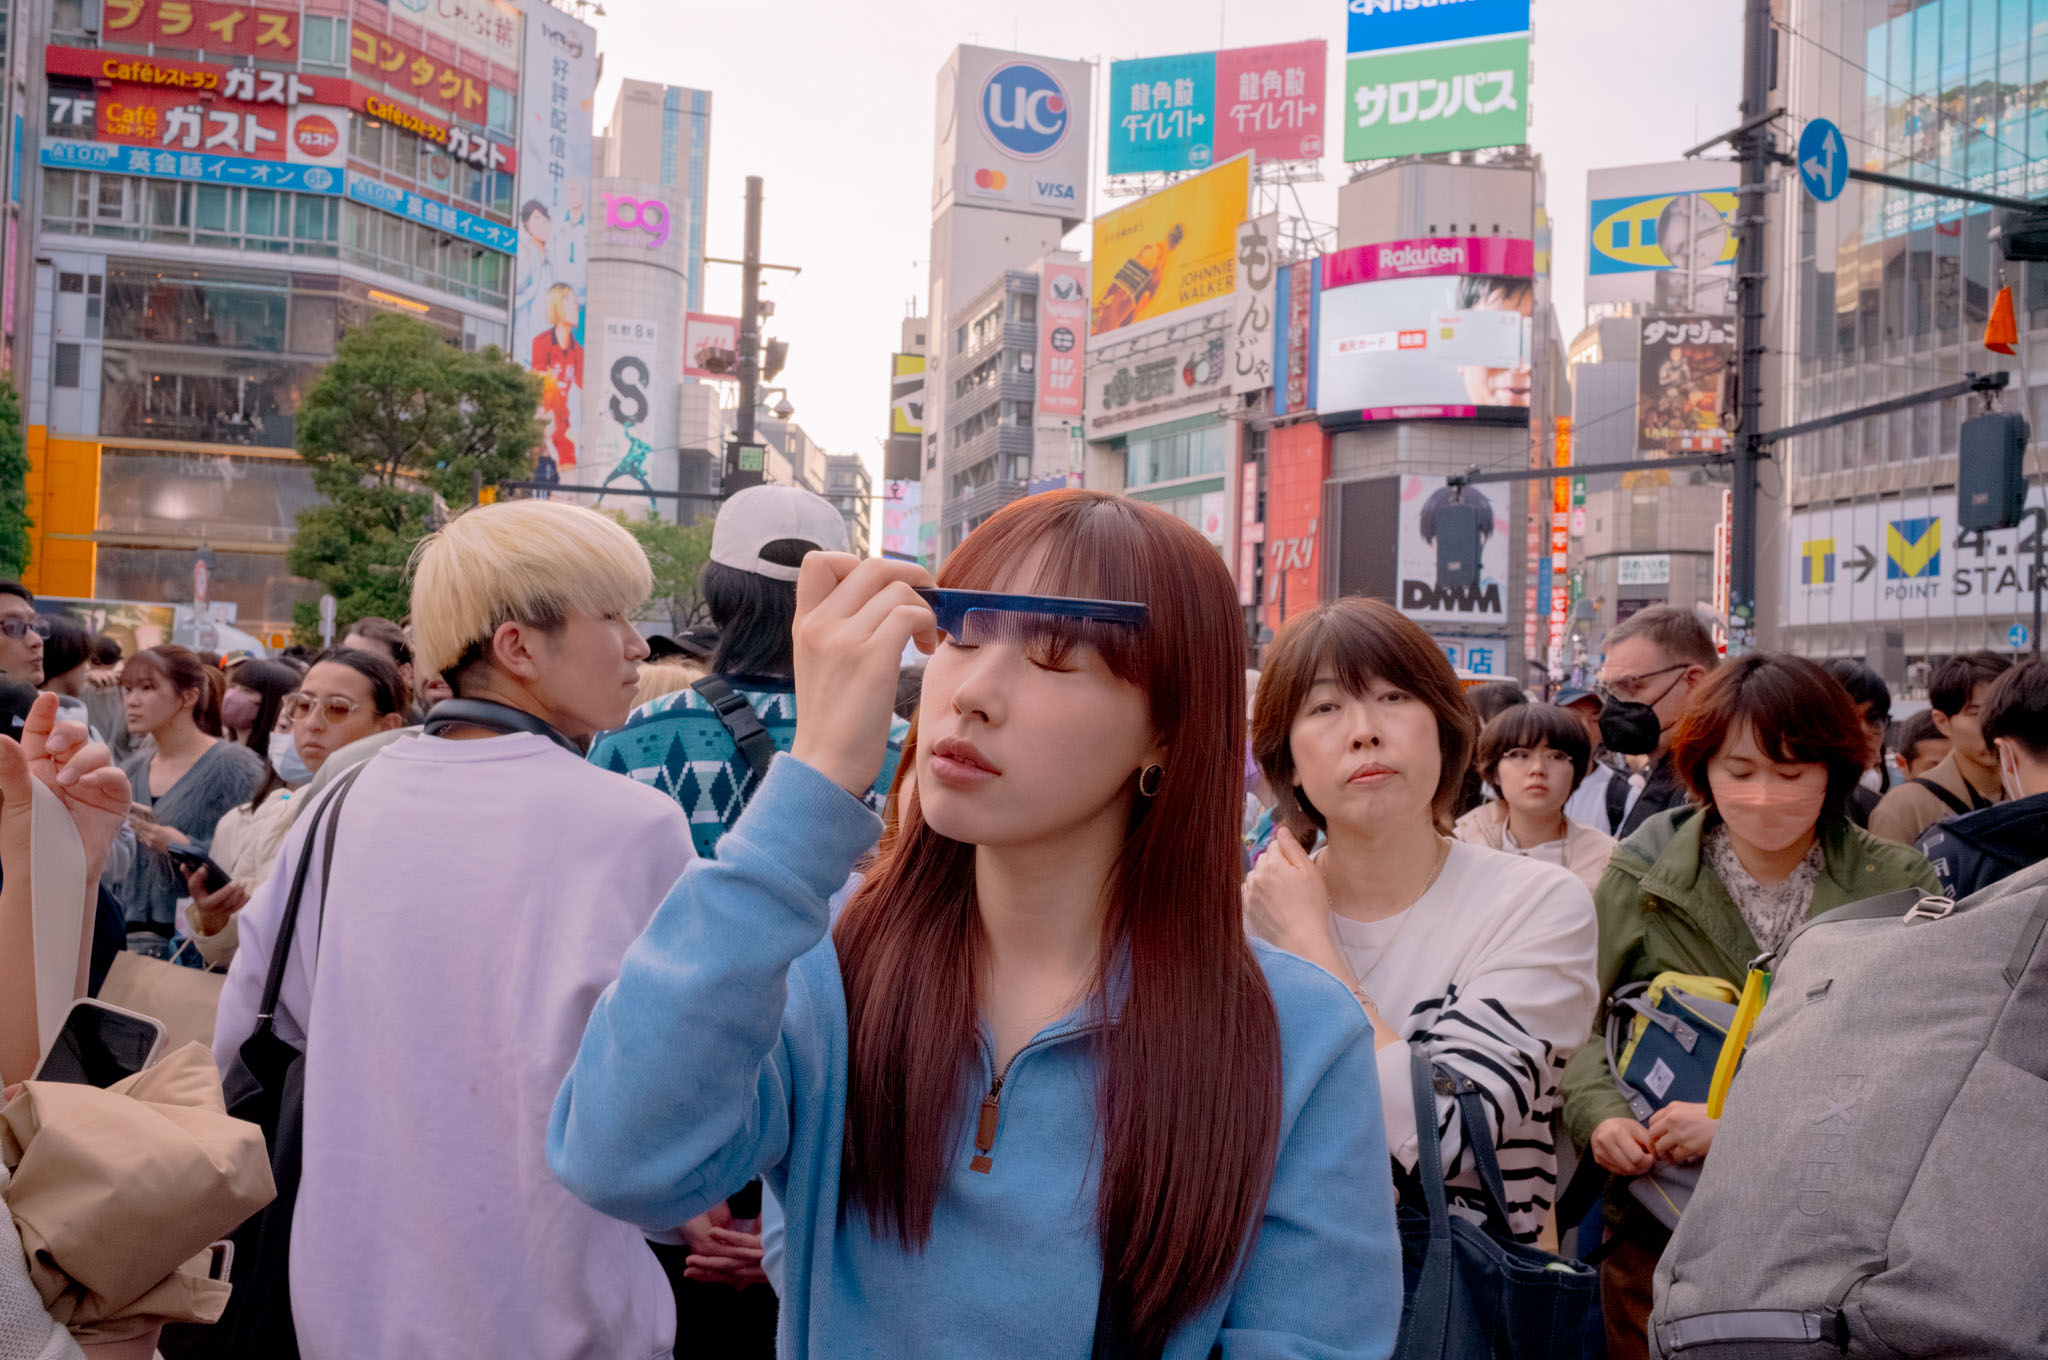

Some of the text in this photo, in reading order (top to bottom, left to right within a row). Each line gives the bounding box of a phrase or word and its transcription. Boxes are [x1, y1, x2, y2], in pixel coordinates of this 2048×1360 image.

[107, 0, 293, 49] プライス
[223, 66, 314, 105] ガスト
[352, 27, 482, 109] コンタクト
[50, 97, 97, 125] 7F
[106, 103, 158, 123] Café
[1354, 69, 1518, 128] サロンパス
[163, 105, 278, 153] ガスト
[51, 144, 109, 165] AEON
[448, 127, 507, 169] ガスト
[1035, 180, 1075, 200] VISA
[602, 192, 670, 248] 109
[1180, 258, 1235, 288] JOHNNIE
[1379, 245, 1465, 269] Rakuten
[1179, 274, 1235, 303] WALKER
[1235, 221, 1272, 383] もんじゃ
[1402, 579, 1502, 615] DMM
[1885, 582, 1941, 600] POINT
